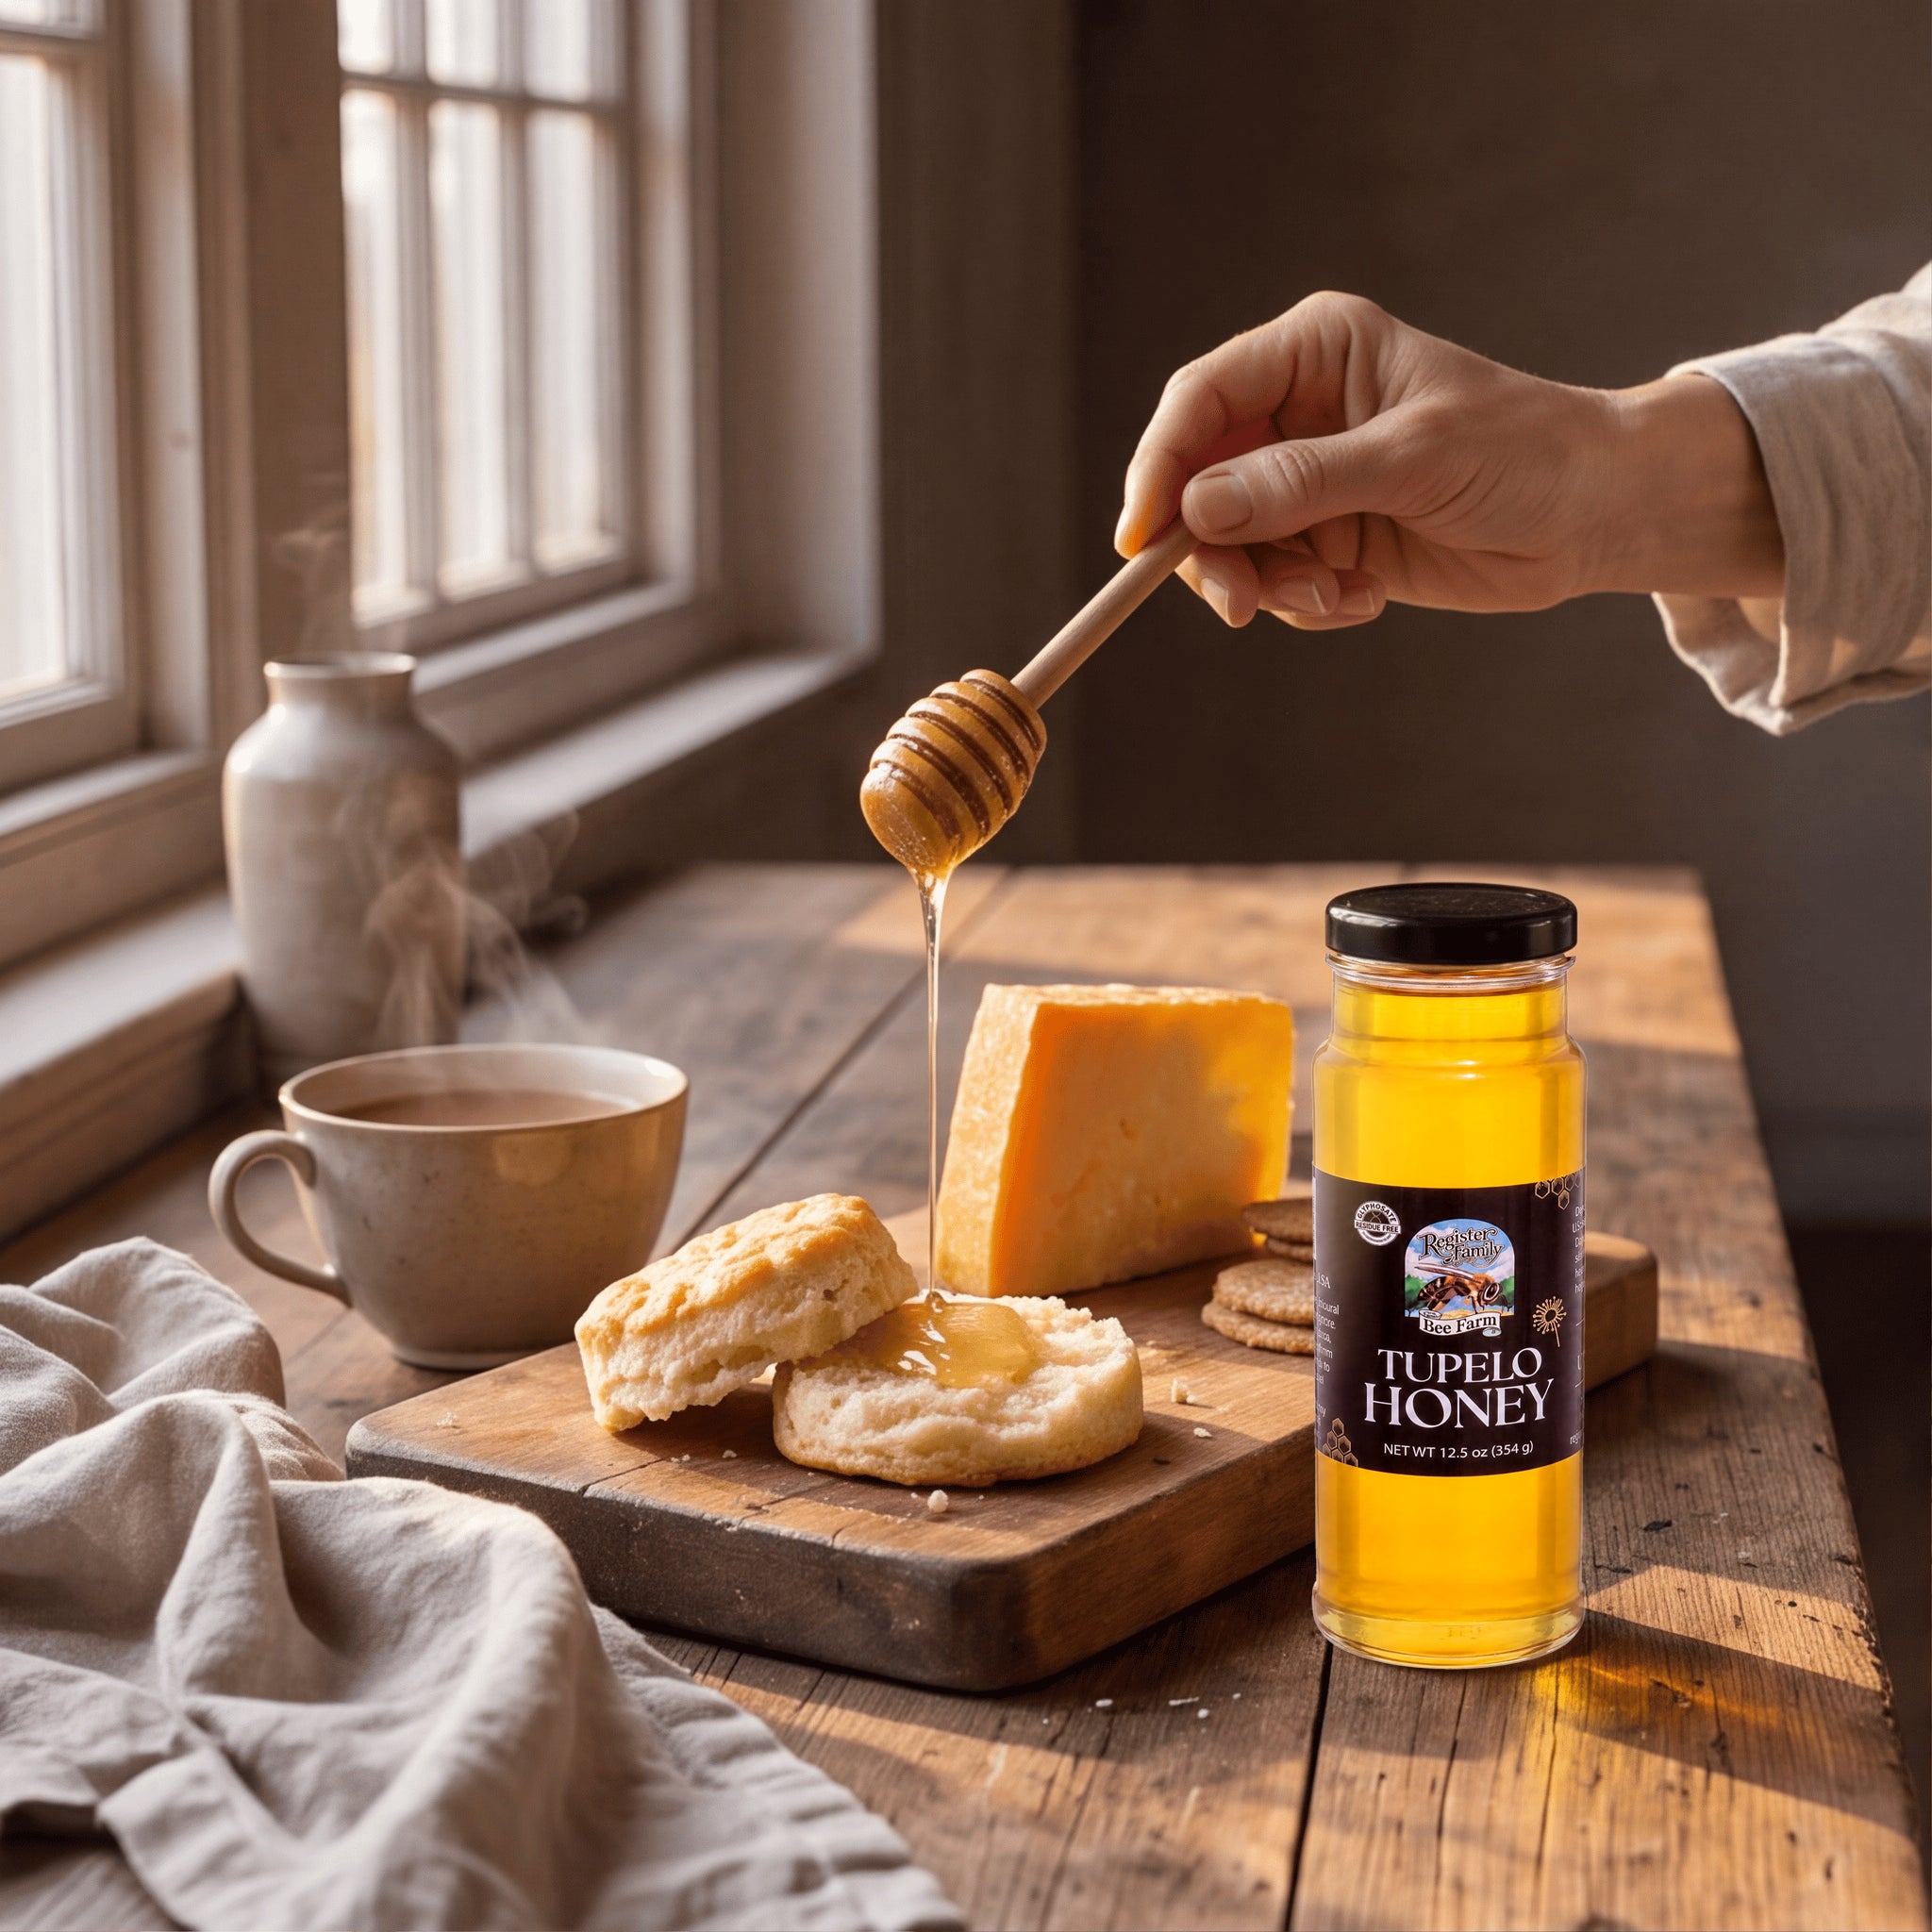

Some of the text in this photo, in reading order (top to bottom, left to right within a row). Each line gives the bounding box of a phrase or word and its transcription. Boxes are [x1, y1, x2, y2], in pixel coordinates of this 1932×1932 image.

[1357, 1203, 1397, 1223] GLYPHOSATE
[1356, 1221, 1381, 1231] RESIDUE
[1417, 1227, 1498, 1261] Register
[1442, 1241, 1505, 1268] Family
[1424, 1315, 1498, 1334] Bee Farm
[1377, 1347, 1542, 1384] TUPELO
[1364, 1377, 1555, 1429] HONEY
[1384, 1441, 1534, 1458] NET WT 12.5 oz (354 g)
